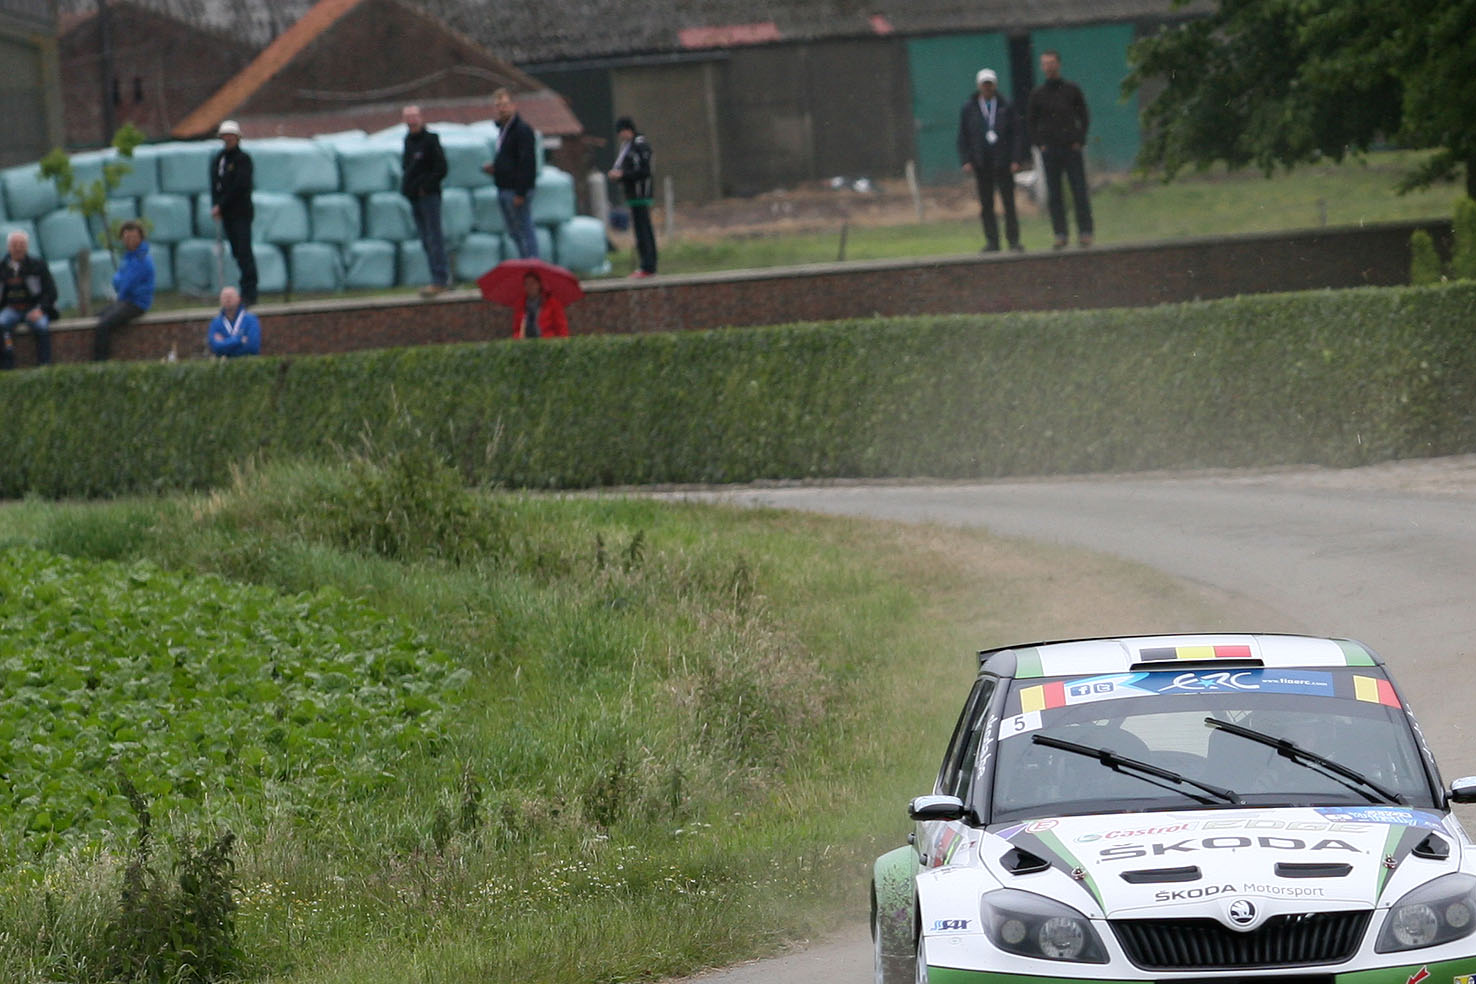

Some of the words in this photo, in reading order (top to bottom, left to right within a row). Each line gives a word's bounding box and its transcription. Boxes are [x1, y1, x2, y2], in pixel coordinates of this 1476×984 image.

[1014, 716, 1026, 731] 5
[1104, 823, 1189, 840] Castrol
[1201, 819, 1374, 834] EDGE
[1099, 836, 1363, 862] ŠKODA
[1155, 884, 1237, 902] ŠKODA
[1244, 883, 1324, 897] Motorsport
